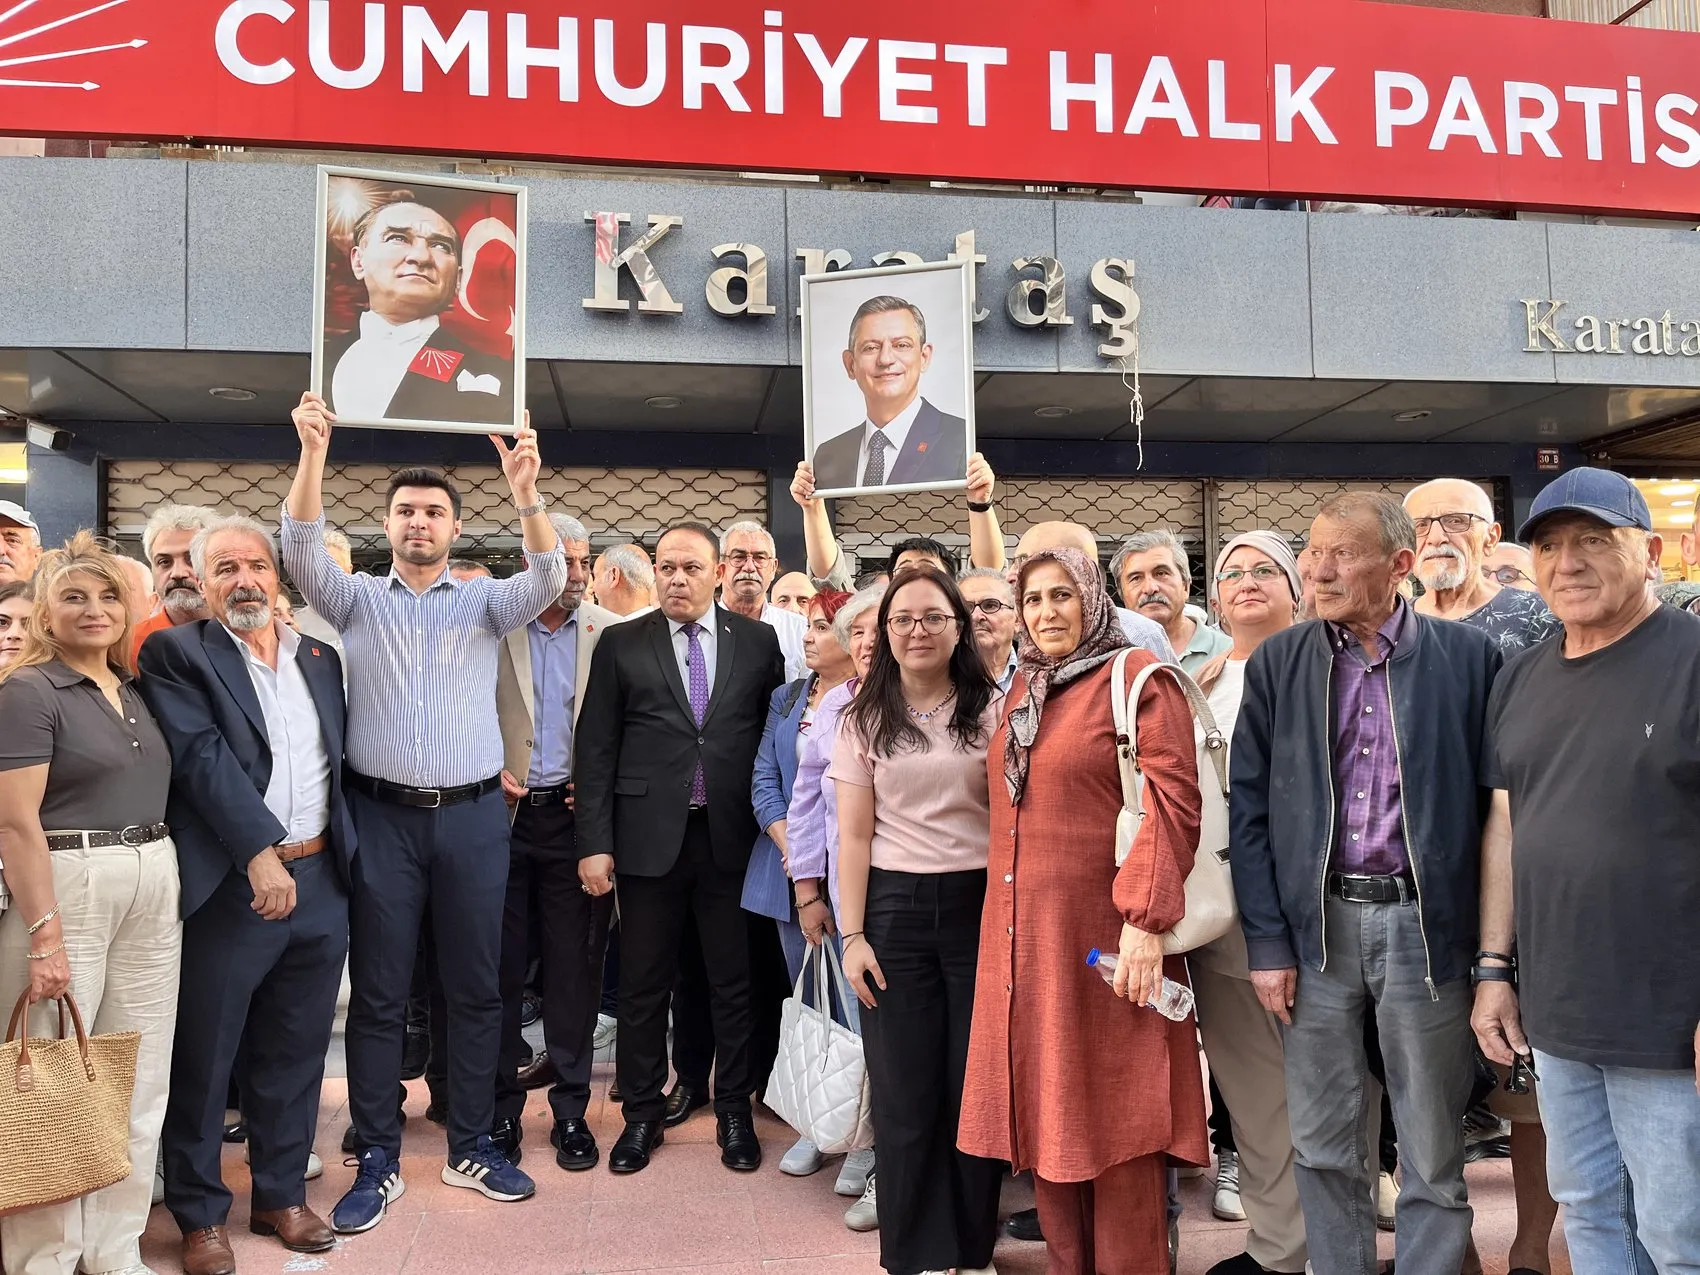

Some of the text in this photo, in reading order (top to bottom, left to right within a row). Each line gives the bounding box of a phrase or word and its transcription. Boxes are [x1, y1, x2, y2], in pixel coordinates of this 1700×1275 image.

[215, 0, 1700, 168] CUMHURİYET HALK PARTİS
[1539, 454, 1559, 464] 30 B
